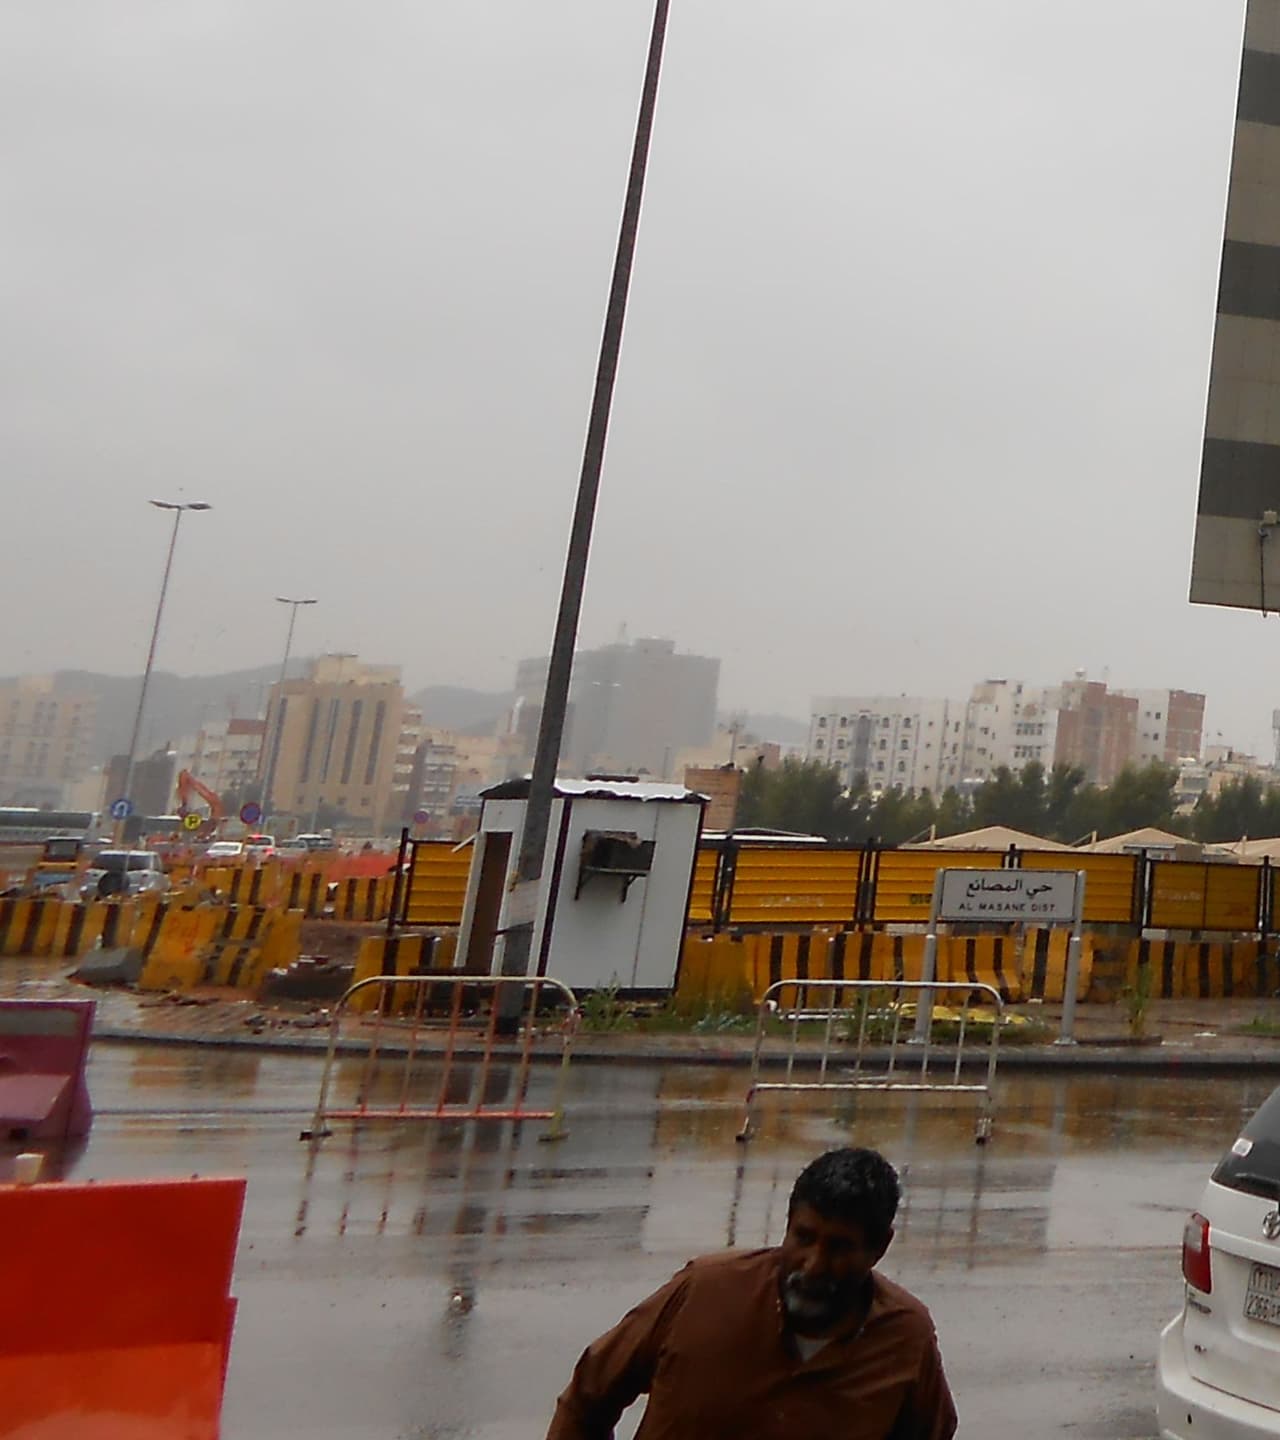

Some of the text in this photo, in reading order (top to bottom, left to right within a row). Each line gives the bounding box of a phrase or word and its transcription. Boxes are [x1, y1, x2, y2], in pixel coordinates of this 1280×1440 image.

[966, 878, 1053, 900] حي المصانع
[959, 903, 973, 911] AL
